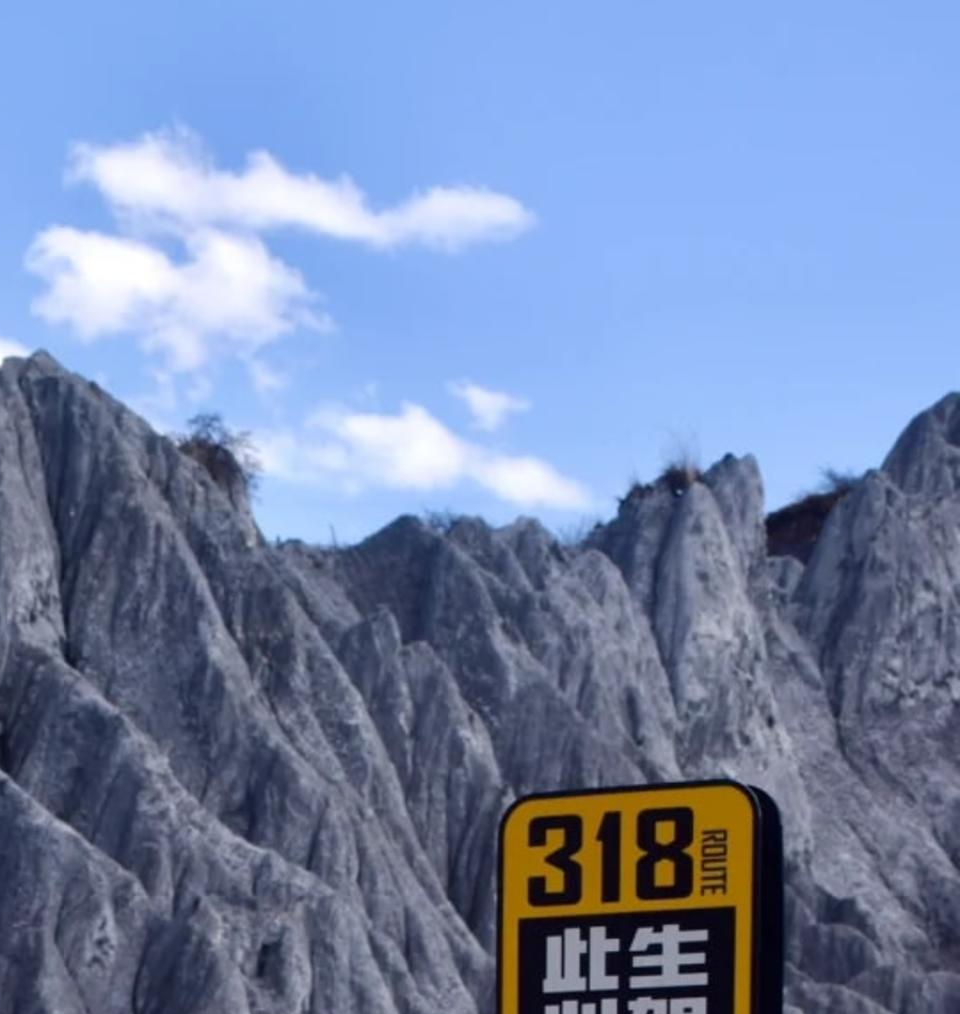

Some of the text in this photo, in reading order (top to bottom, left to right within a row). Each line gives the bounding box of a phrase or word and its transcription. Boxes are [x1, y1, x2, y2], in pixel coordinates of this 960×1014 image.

[527, 807, 694, 907] 318
[700, 828, 728, 897] ROUTE
[542, 924, 709, 993] 此生
